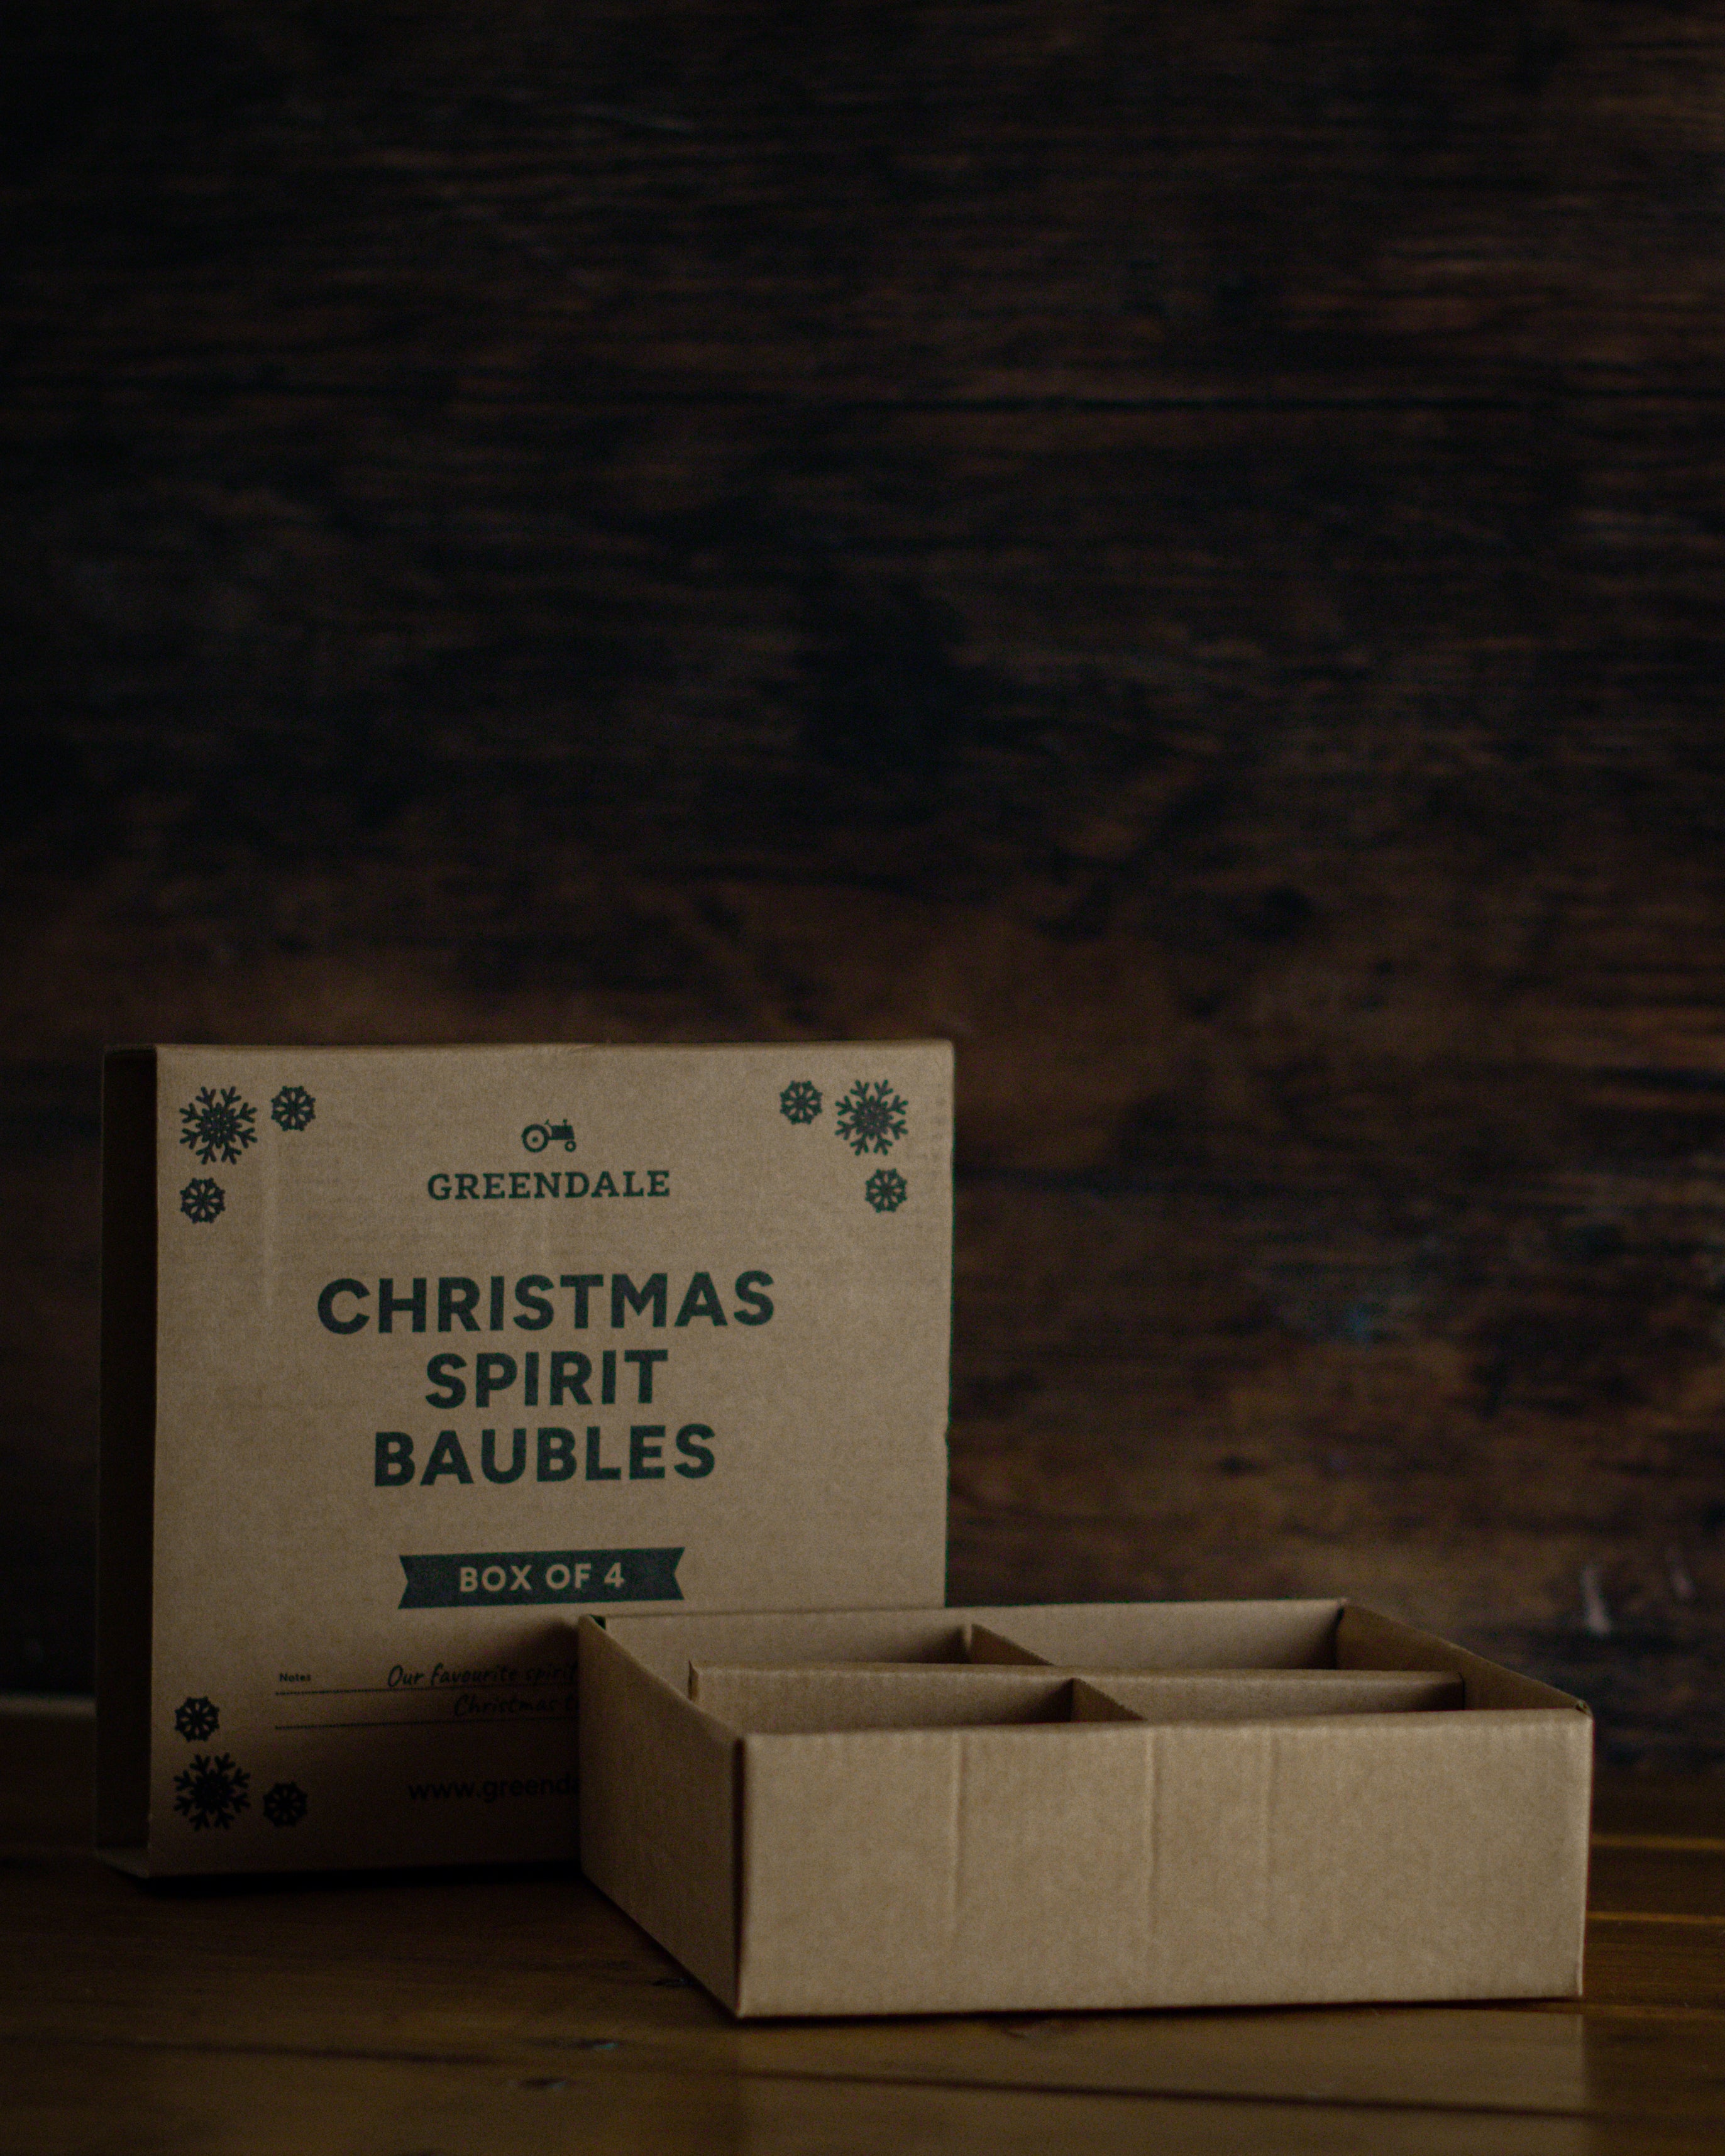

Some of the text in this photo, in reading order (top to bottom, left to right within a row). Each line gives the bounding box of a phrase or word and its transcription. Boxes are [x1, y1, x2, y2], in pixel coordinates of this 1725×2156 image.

[427, 1170, 671, 1201] GREENDALE
[317, 1270, 774, 1336] CHRISTMAS
[424, 1349, 669, 1409] SPIRIT
[374, 1423, 716, 1488] BAUBLES
[458, 1562, 625, 1593] BOX OF 4
[278, 1672, 312, 1683] Notes
[387, 1664, 424, 1688] Our
[430, 1663, 517, 1686] favourite
[453, 1694, 559, 1717] Christmas
